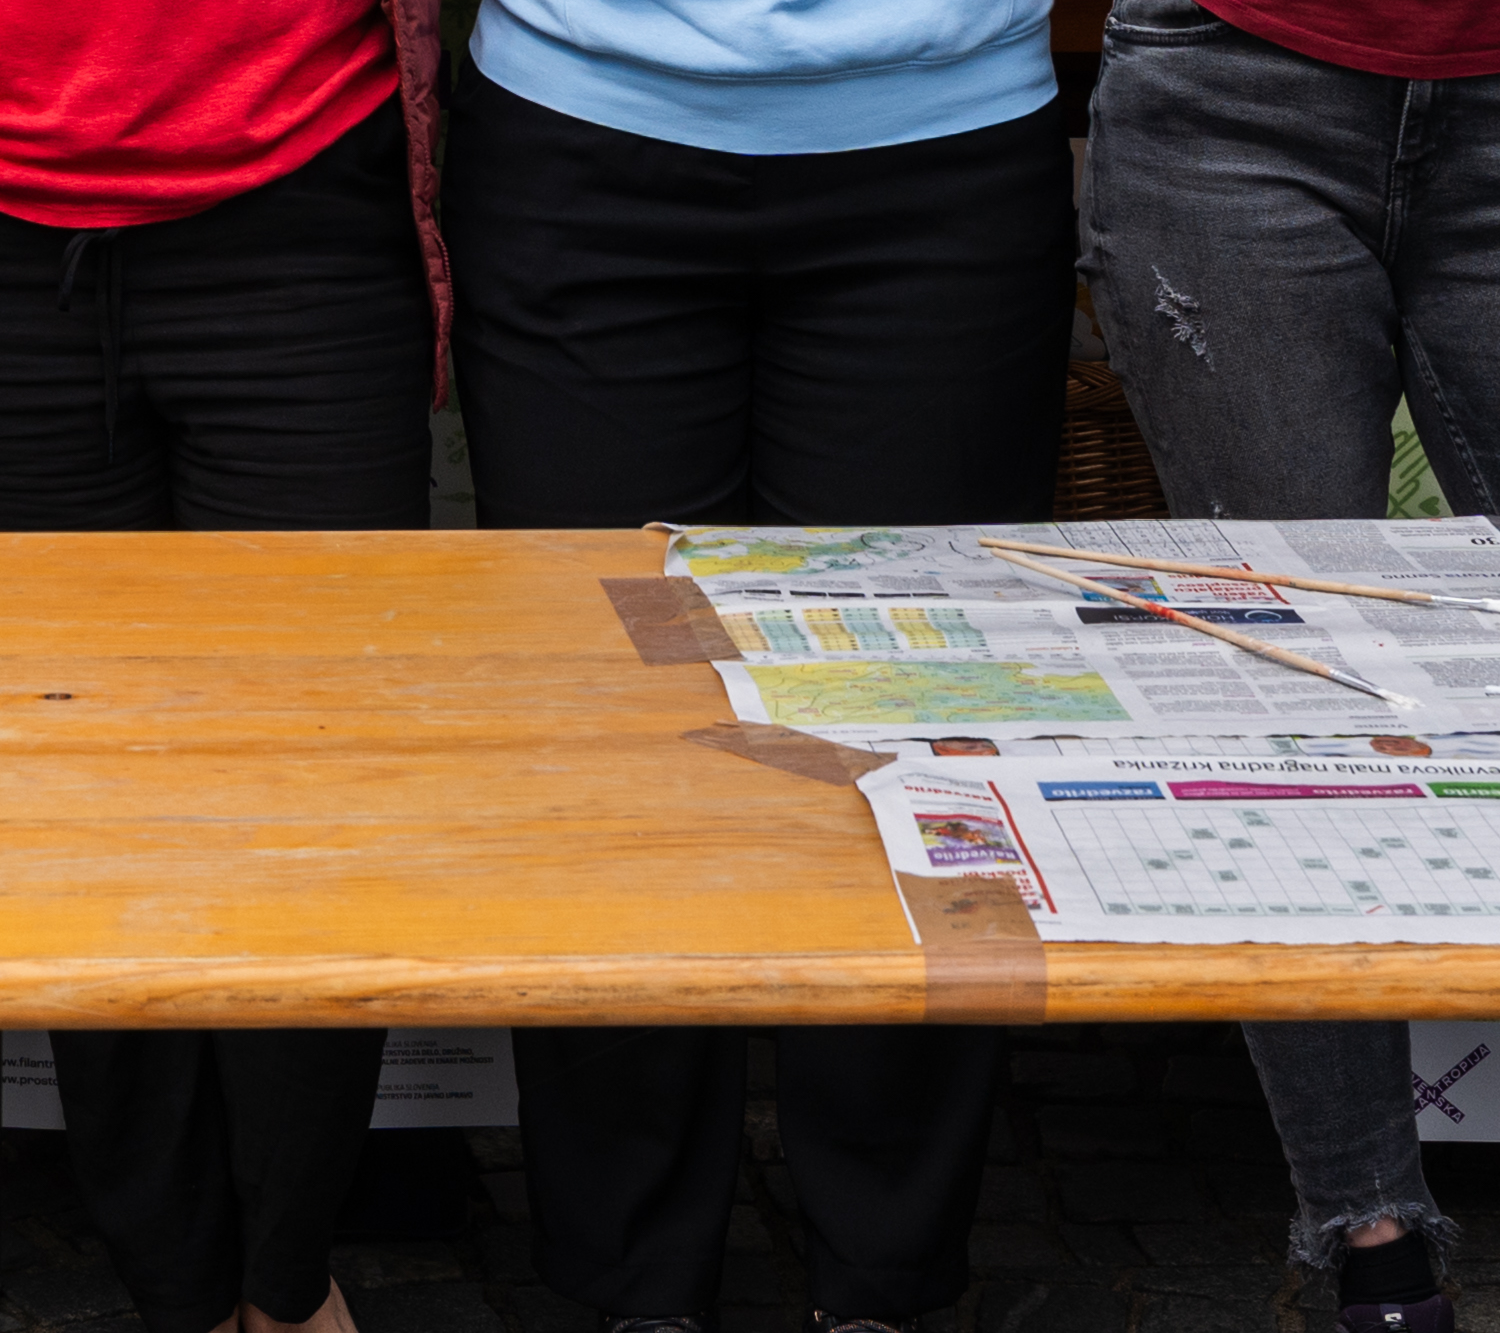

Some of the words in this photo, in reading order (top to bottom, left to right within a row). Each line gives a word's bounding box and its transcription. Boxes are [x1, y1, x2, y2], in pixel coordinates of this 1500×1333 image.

[1219, 760, 1328, 773] nagradna
[1334, 763, 1390, 776] mala
[1052, 787, 1154, 798] razvedrilo
[933, 850, 1016, 861] Razvedrilo
